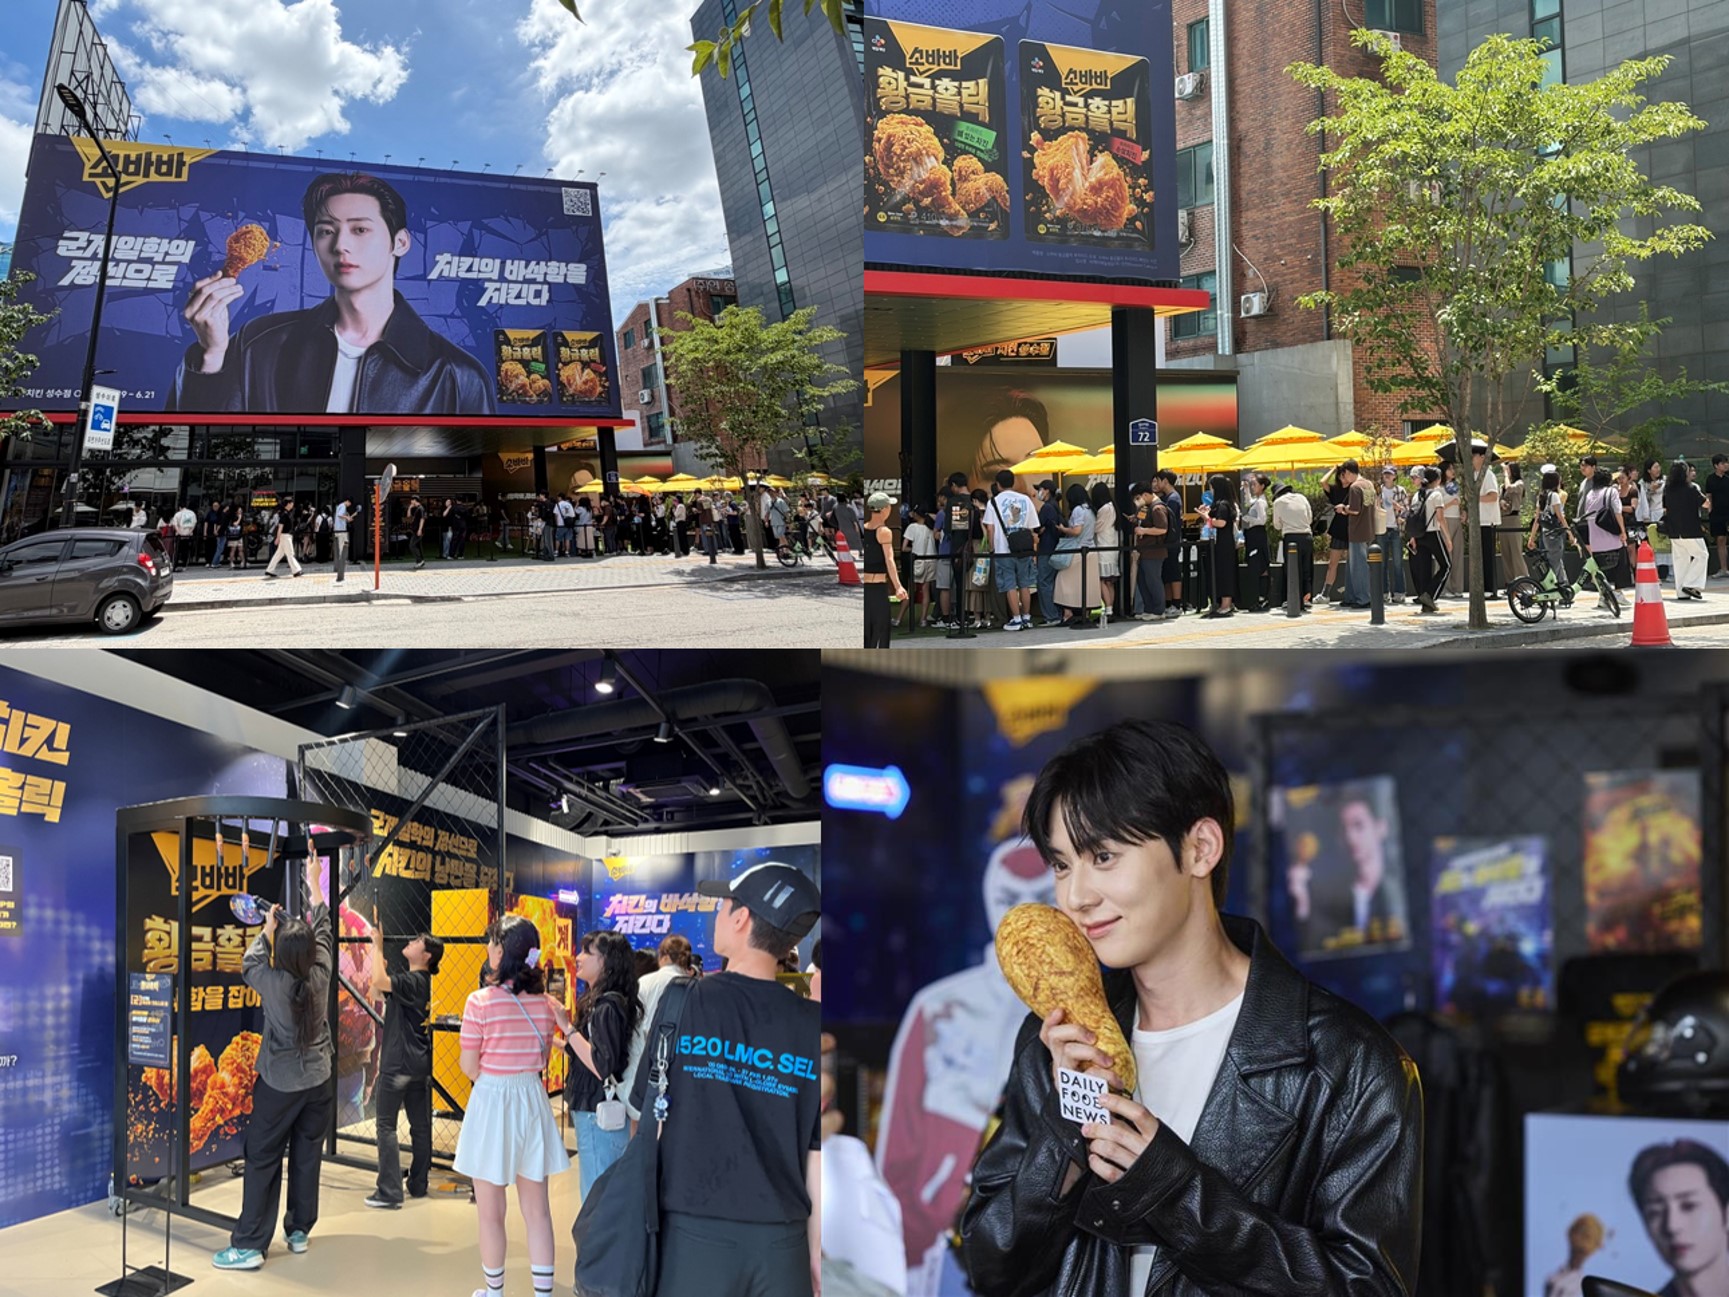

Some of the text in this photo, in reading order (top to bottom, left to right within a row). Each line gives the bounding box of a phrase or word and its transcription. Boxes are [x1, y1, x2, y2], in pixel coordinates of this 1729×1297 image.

[908, 47, 959, 67] 소바바
[1064, 67, 1109, 87] 소바바
[877, 65, 989, 123] 황금홀릭
[1036, 86, 1136, 140] 황금홀릭
[88, 151, 186, 178] 소바바
[57, 260, 179, 289] 정신으로
[427, 253, 587, 285] 치킨의 바삭함을
[477, 282, 549, 306] 지킨다
[26, 388, 44, 399] 치킨
[45, 388, 72, 399] 성수점
[135, 390, 155, 399] 6.21
[1137, 431, 1150, 442] 72
[603, 893, 659, 918] 치킨의
[612, 914, 671, 935] 지킨다
[777, 1052, 817, 1081] SEL
[1061, 1071, 1104, 1094] DAILY
[1063, 1102, 1108, 1125] NEWS
